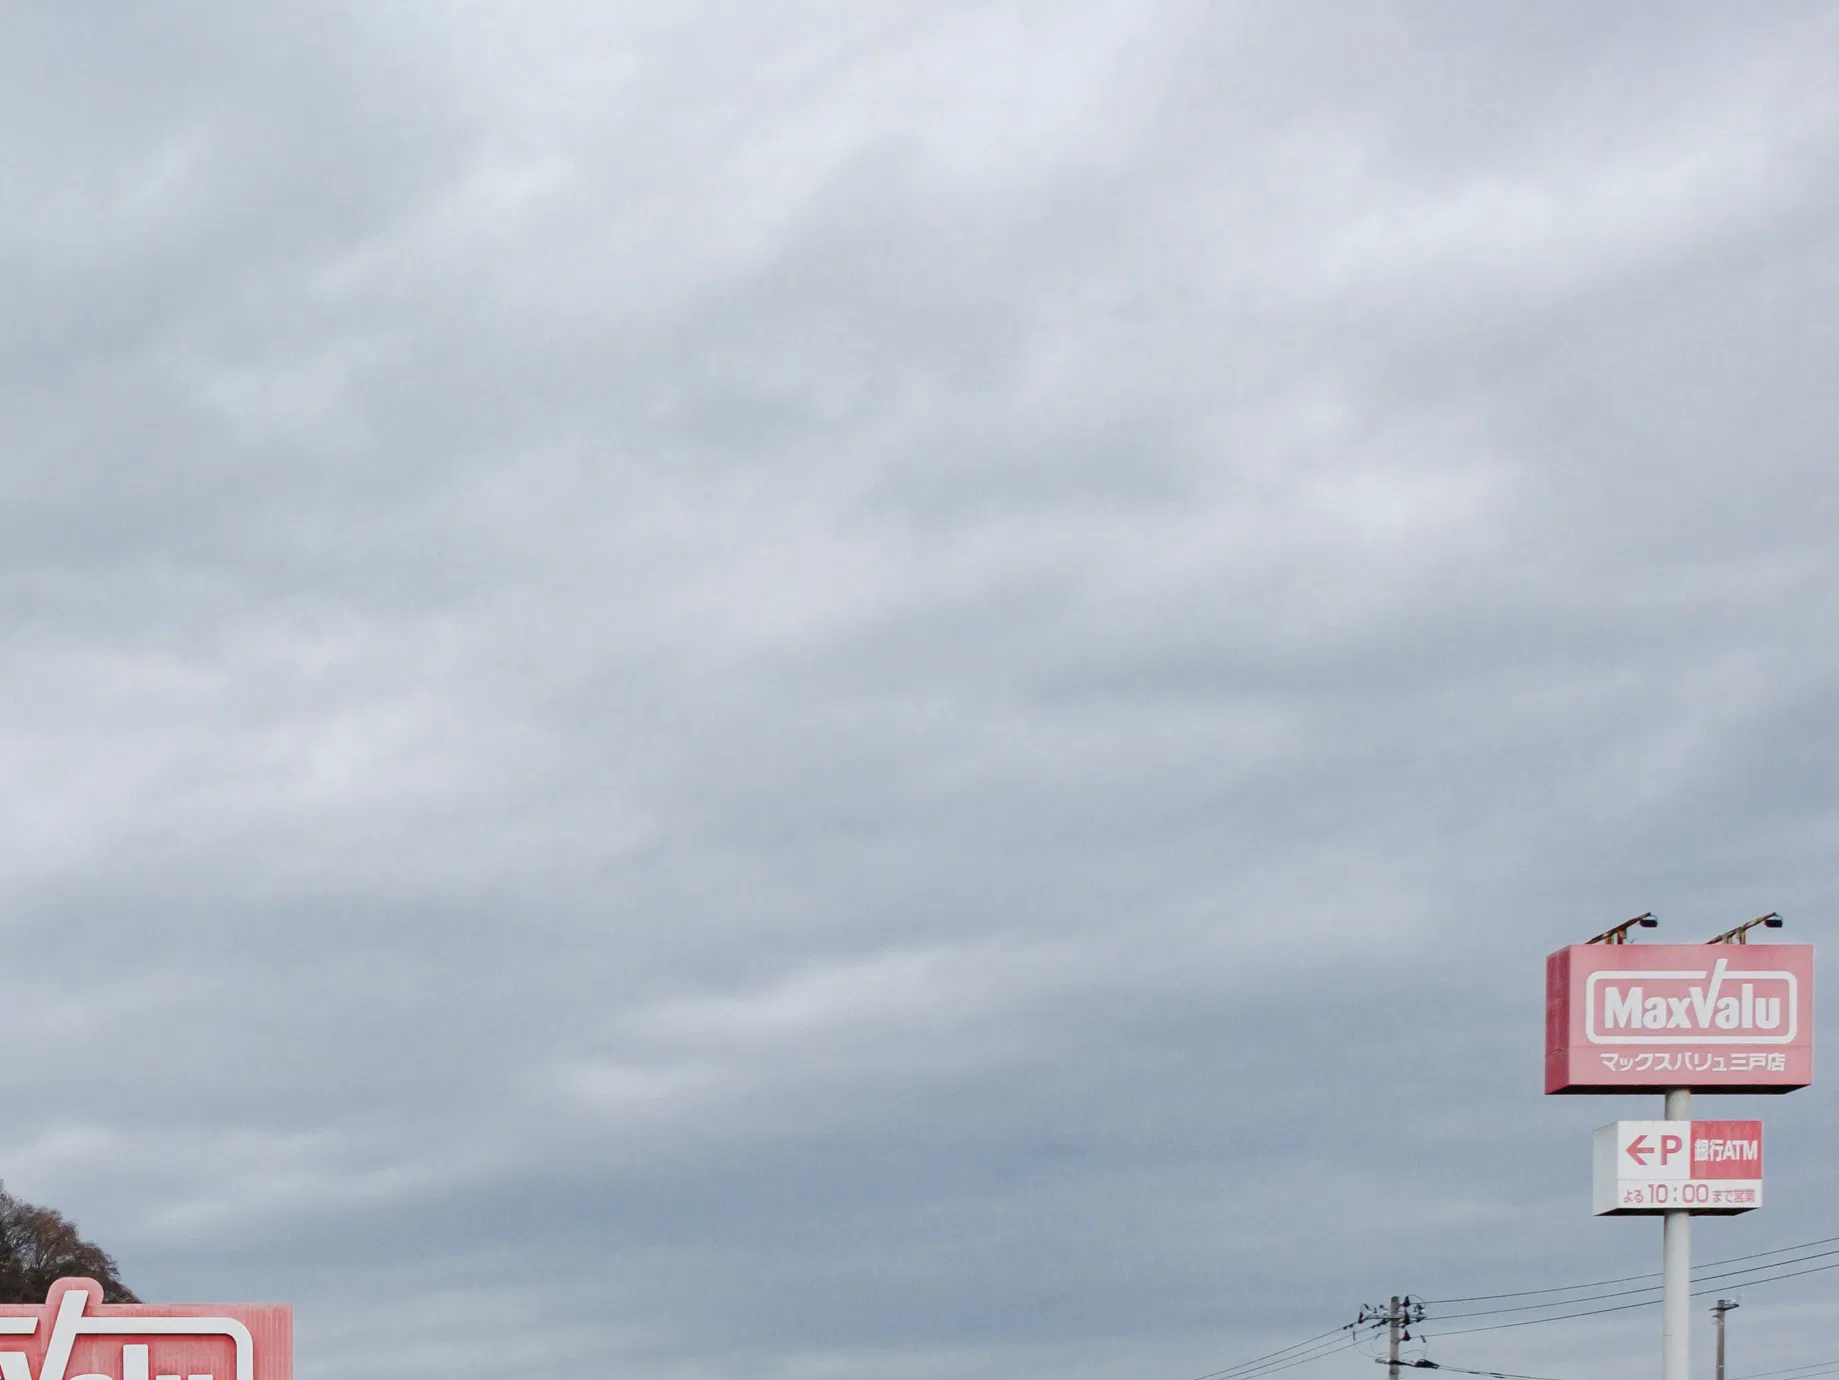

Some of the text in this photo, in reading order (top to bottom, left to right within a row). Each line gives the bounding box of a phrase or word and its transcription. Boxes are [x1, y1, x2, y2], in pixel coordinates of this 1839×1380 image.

[1604, 958, 1781, 1030] MaxValu
[1600, 1052, 1786, 1072] マックスバリュ三戸店
[1660, 1134, 1683, 1166] P
[1694, 1138, 1758, 1162] 銀行ATM
